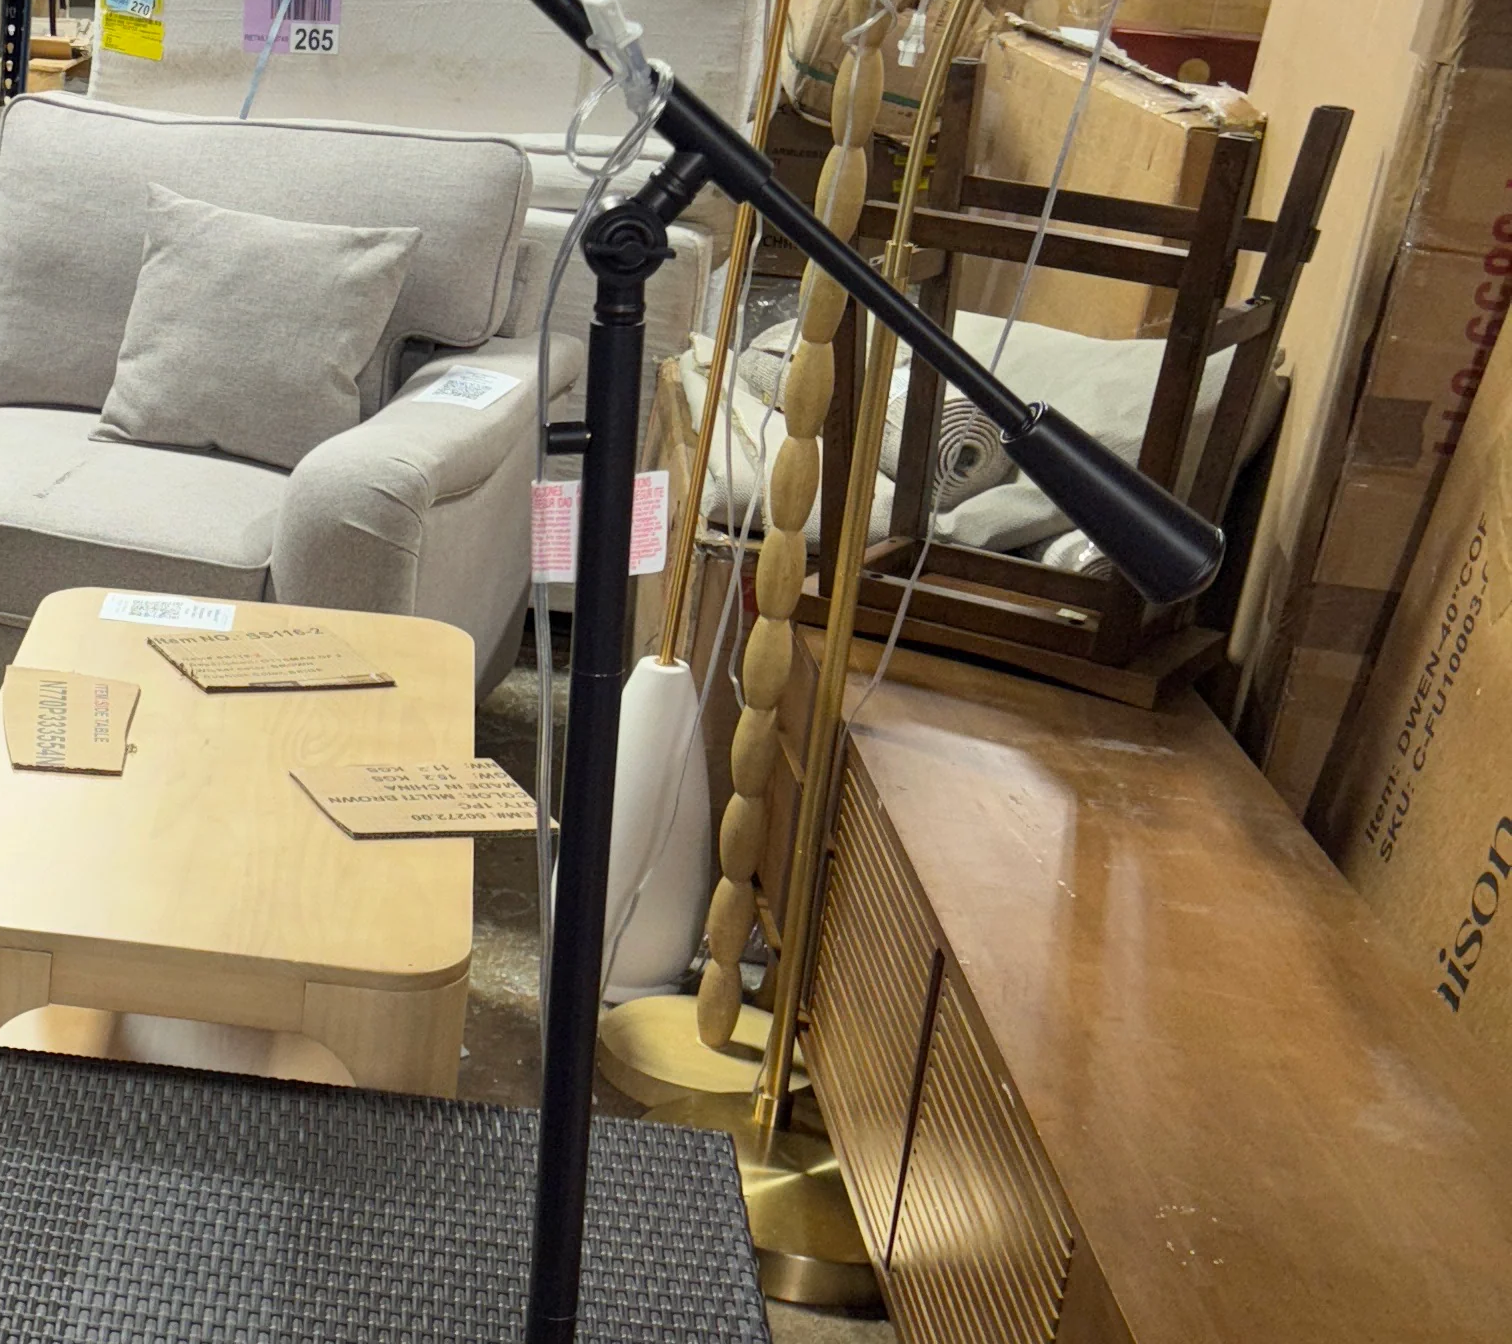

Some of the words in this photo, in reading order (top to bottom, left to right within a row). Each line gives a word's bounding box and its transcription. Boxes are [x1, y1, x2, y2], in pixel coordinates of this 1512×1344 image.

[130, 0, 151, 17] 270
[294, 28, 335, 52] 265
[157, 634, 198, 647] Item
[94, 718, 110, 743] TABLE
[384, 783, 439, 791] CHINA
[404, 793, 455, 801] MULTI
[1364, 763, 1400, 844] Item:
[1380, 780, 1415, 864] SKU:
